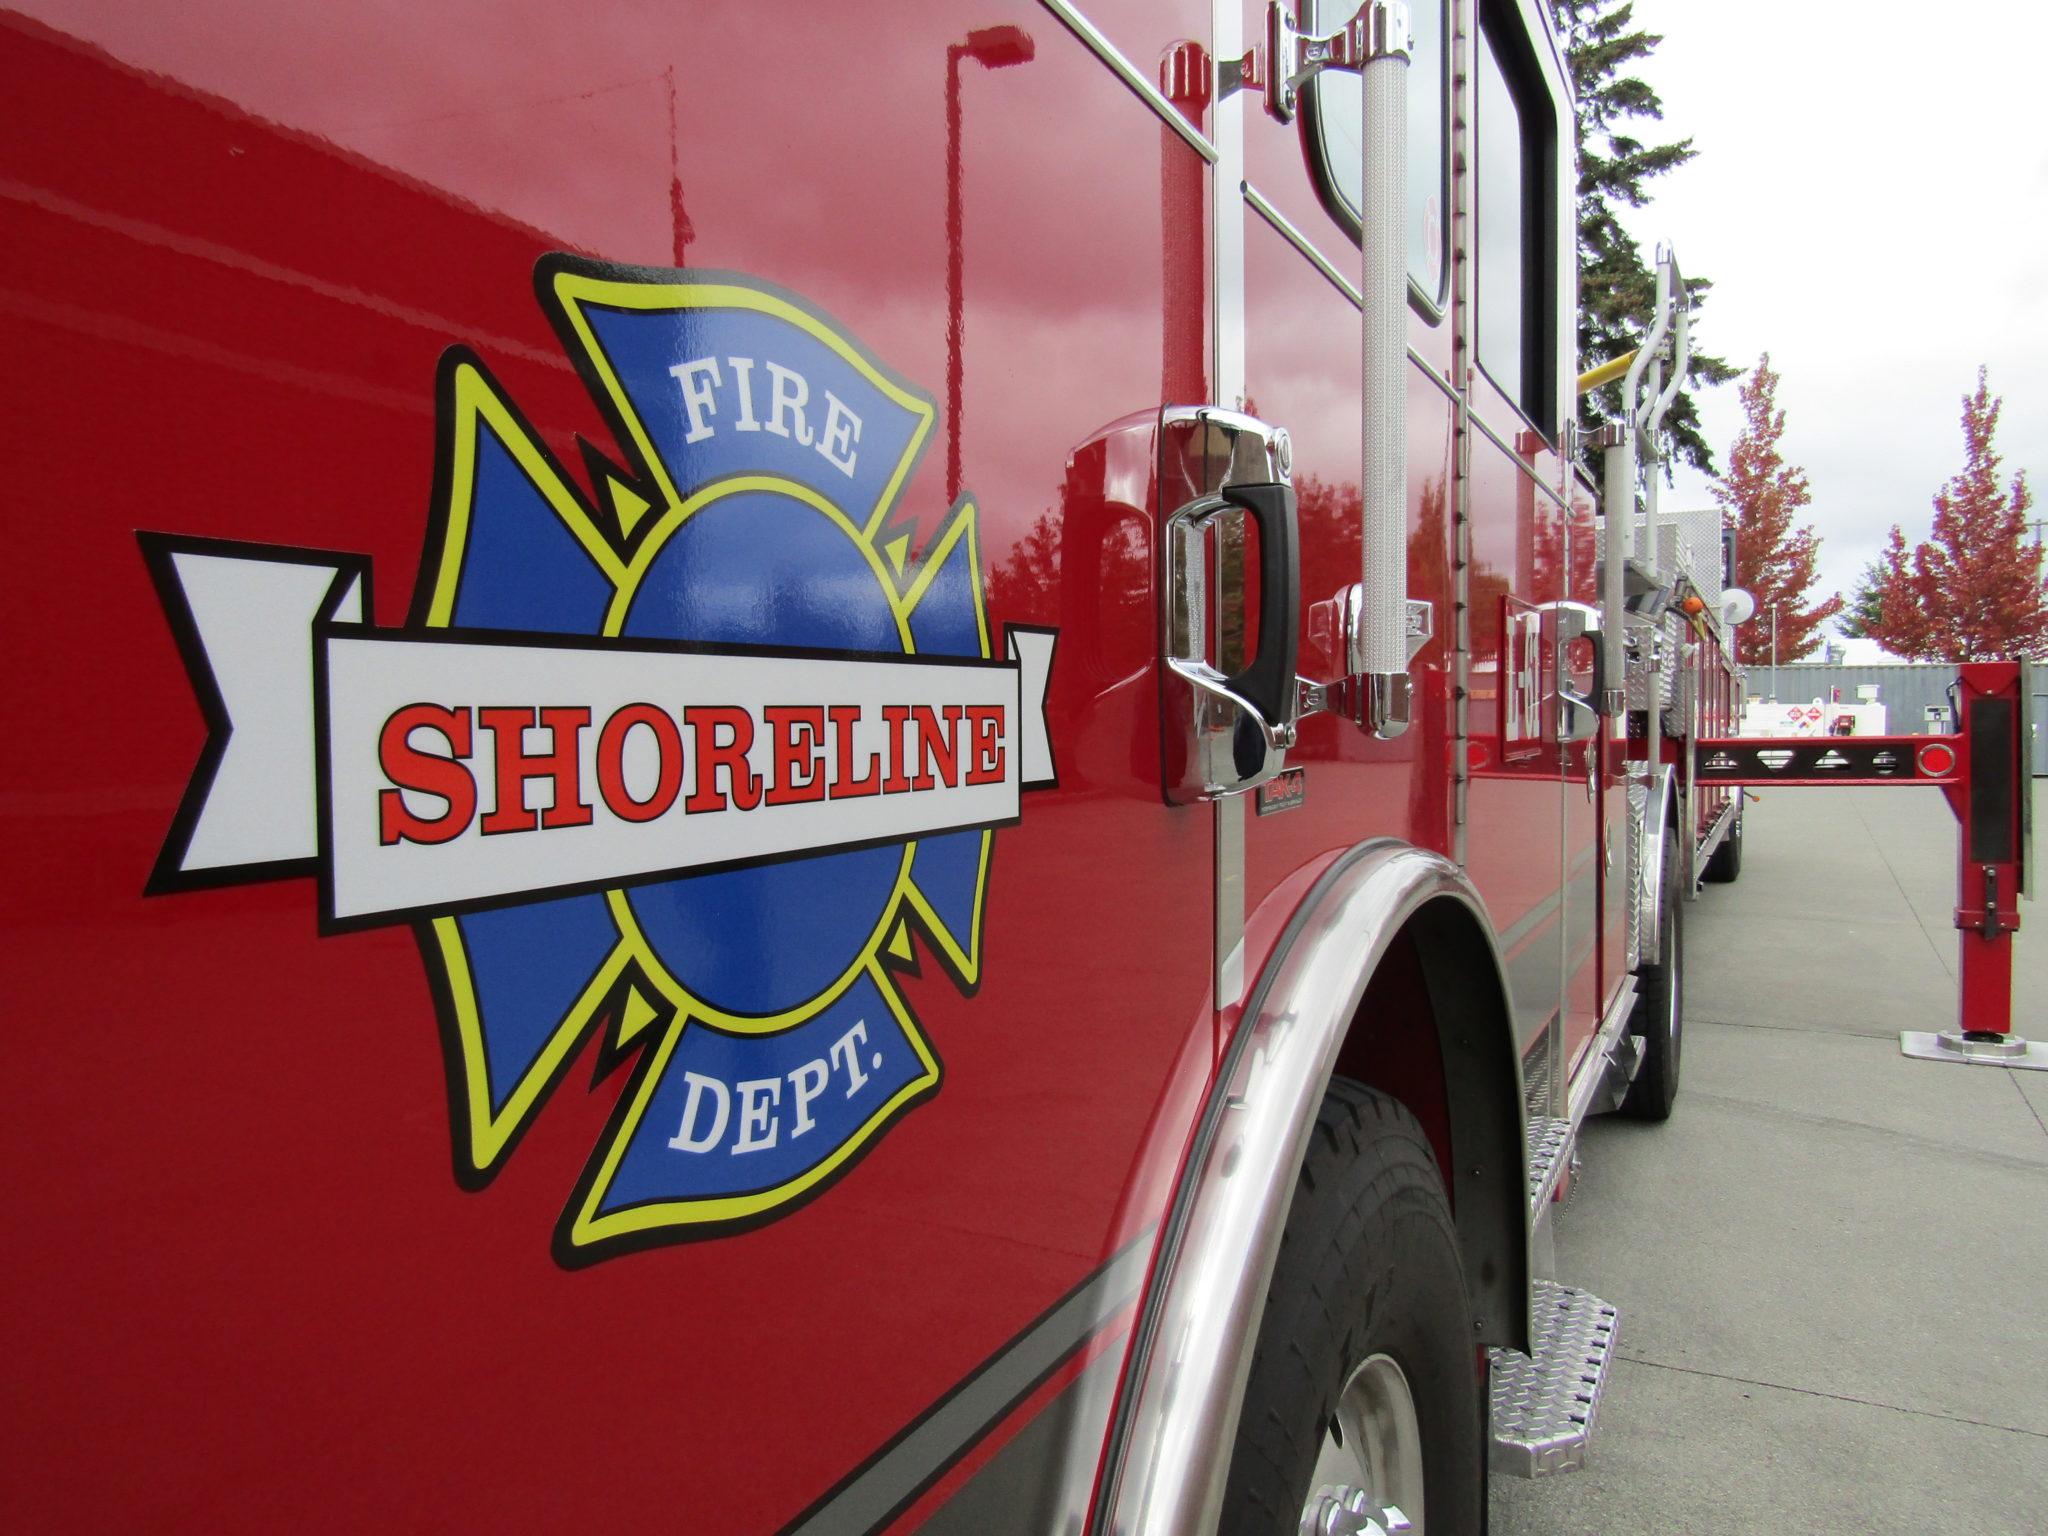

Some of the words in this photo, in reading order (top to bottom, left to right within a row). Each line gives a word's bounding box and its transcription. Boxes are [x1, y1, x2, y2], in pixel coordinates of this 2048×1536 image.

[669, 356, 862, 479] FIRE
[1506, 613, 1540, 741] L-61
[377, 702, 1006, 846] SHORELINE
[1265, 772, 1302, 803] TAK-4
[668, 1019, 882, 1155] DEPT.
